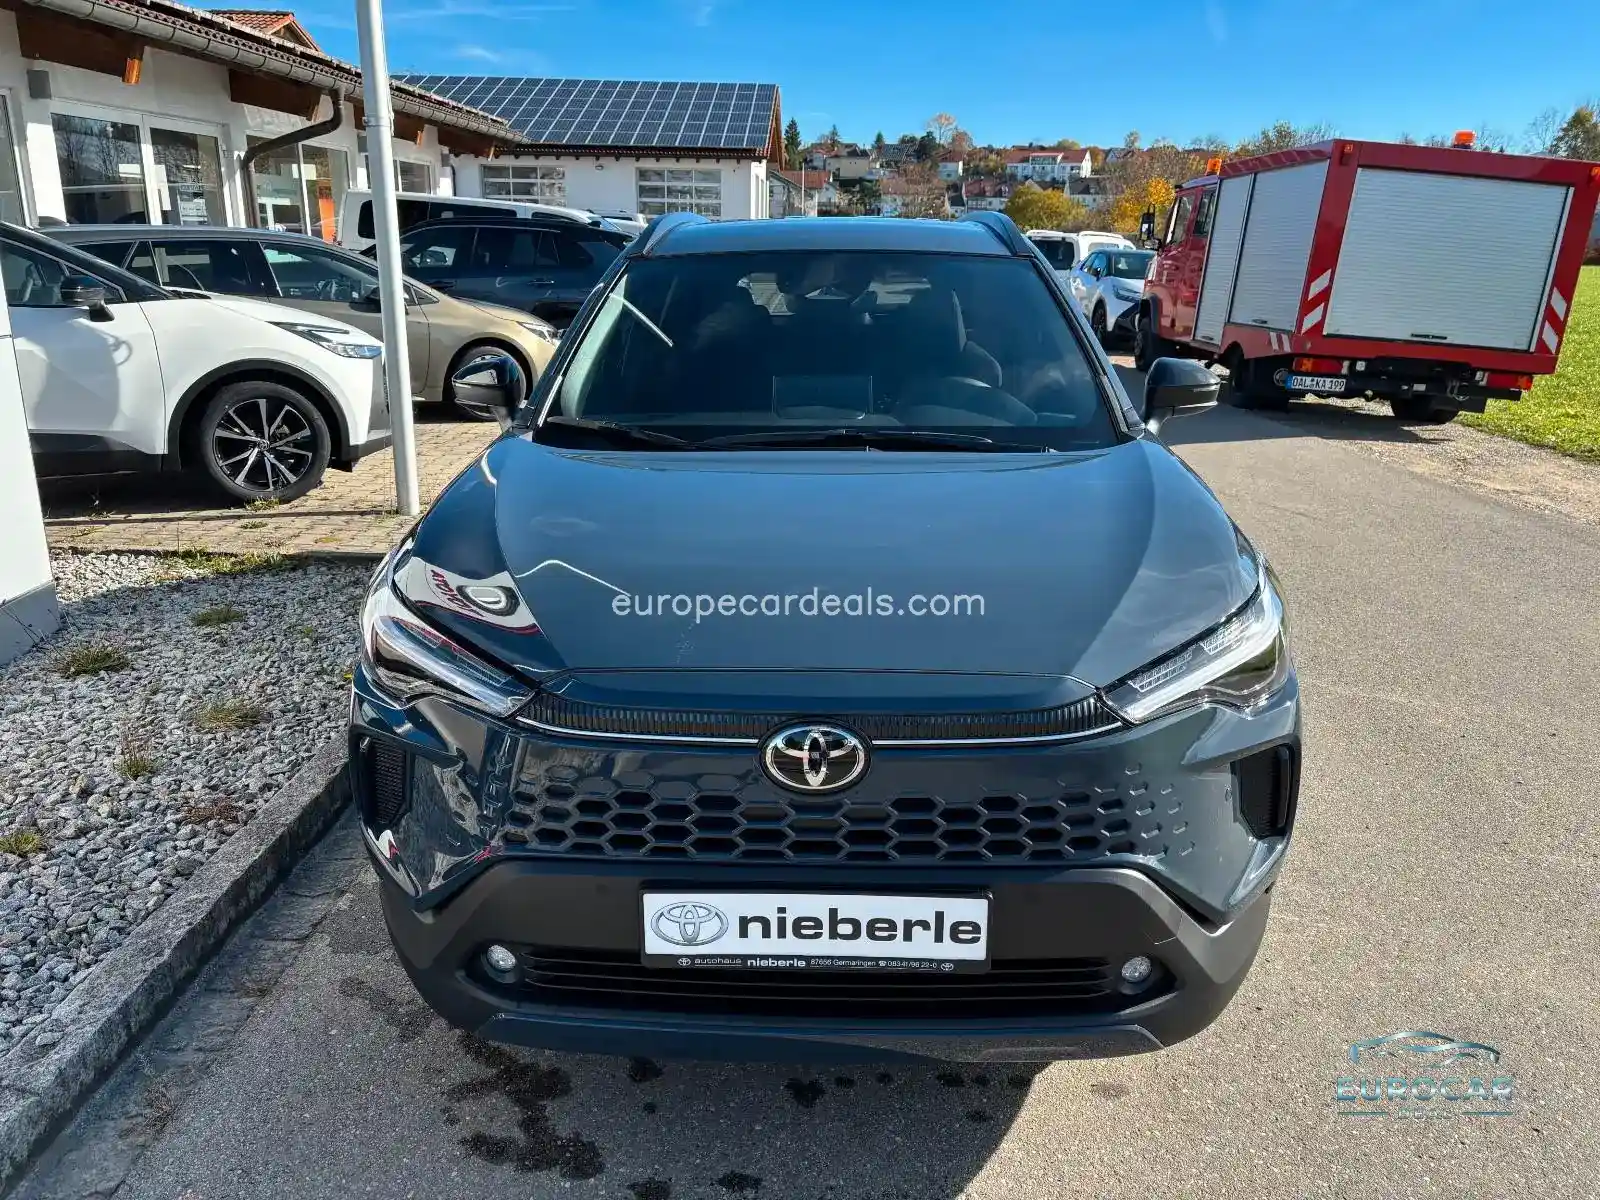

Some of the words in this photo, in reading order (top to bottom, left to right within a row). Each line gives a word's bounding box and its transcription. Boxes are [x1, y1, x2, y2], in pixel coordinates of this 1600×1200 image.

[1293, 376, 1308, 388] OAL
[1315, 378, 1326, 389] KA
[1328, 379, 1345, 391] 199
[738, 906, 982, 945] nieberle
[694, 957, 742, 965] autohaus
[747, 957, 806, 968] nieberle
[833, 959, 876, 968] Germaringen
